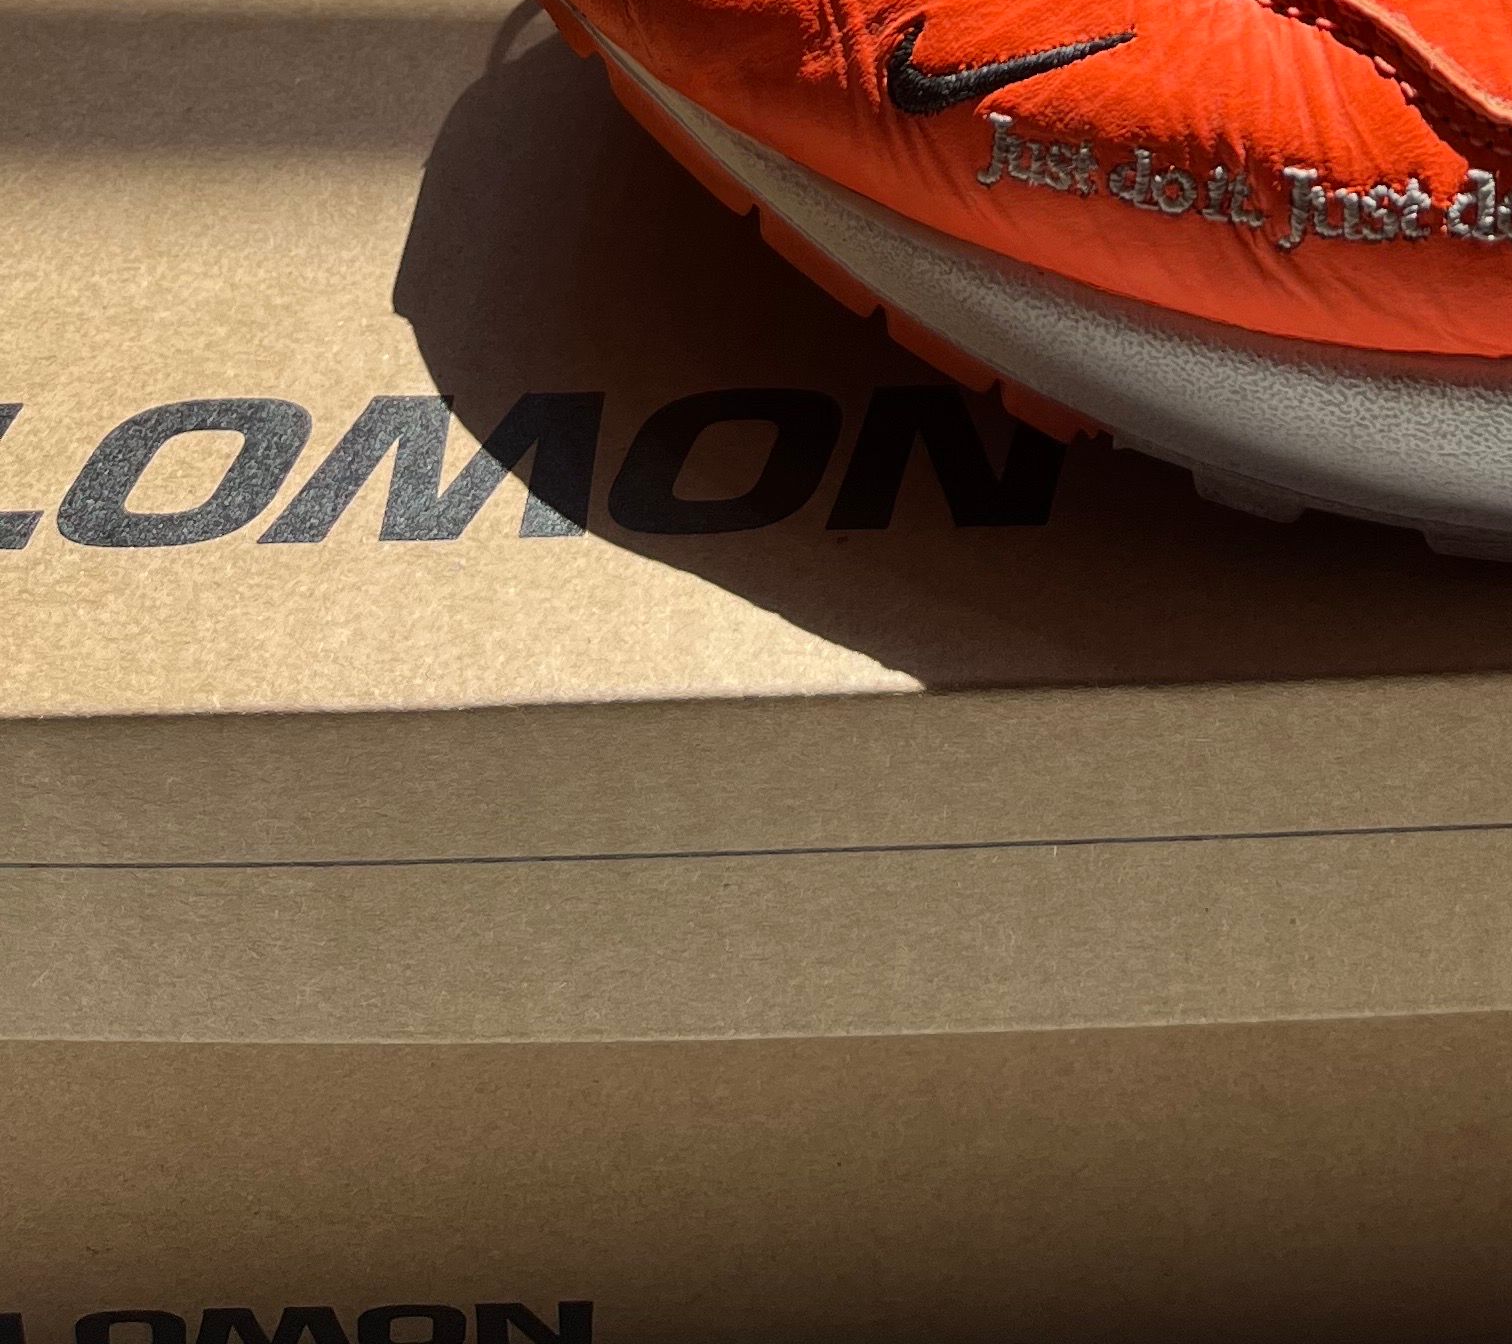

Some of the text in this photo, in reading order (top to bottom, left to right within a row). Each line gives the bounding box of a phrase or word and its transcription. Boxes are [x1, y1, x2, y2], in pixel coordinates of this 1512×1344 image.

[977, 112, 1098, 198] Just
[1108, 148, 1197, 214] do
[1277, 166, 1431, 250] Just
[0, 386, 1067, 549] OMON
